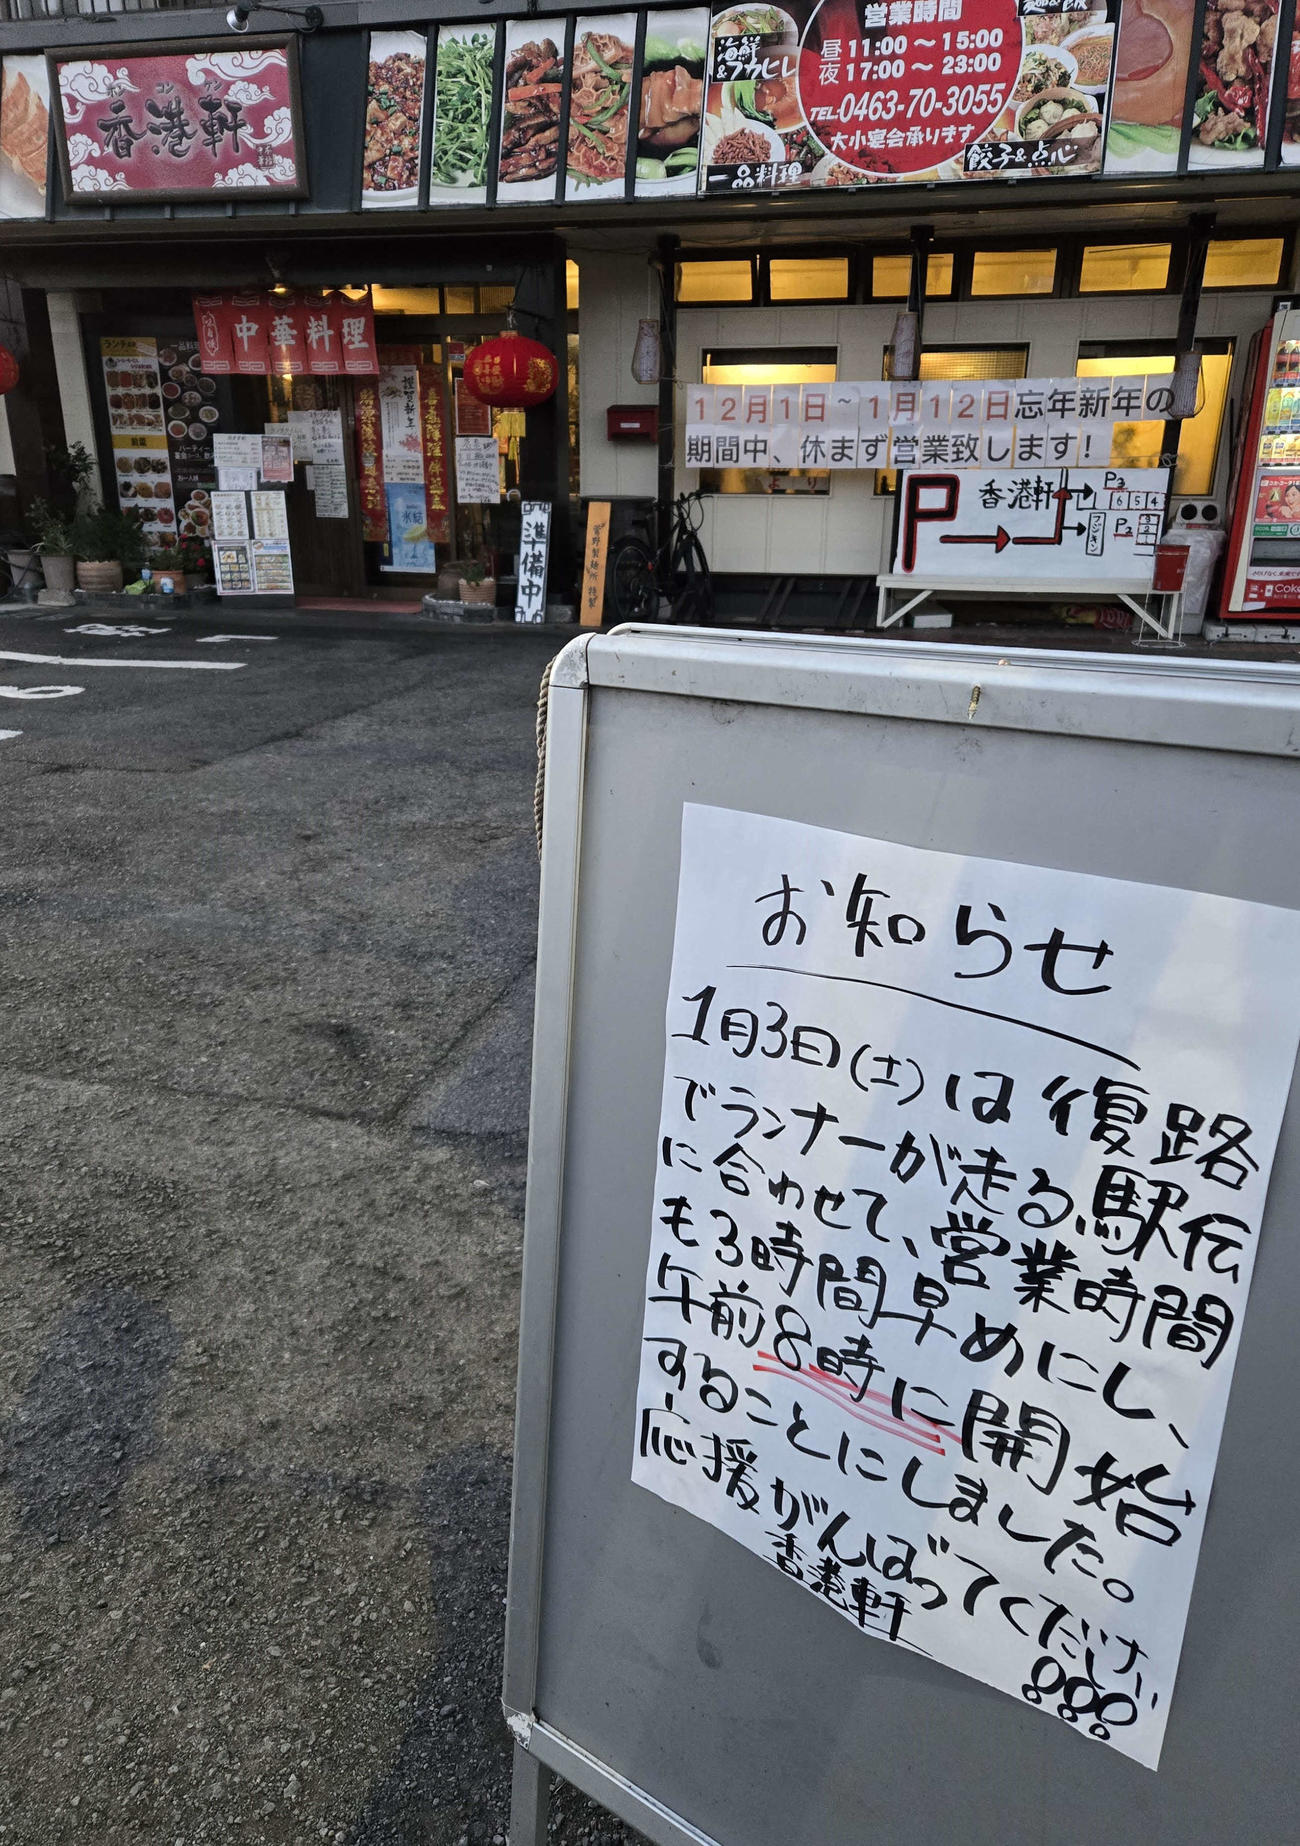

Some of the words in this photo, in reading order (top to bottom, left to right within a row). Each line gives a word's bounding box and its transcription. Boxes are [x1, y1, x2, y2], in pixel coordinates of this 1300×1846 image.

[864, 2, 962, 29] 営業時間
[717, 35, 761, 62] 海鮮
[818, 63, 839, 86] 夜
[846, 59, 905, 82] 17:00
[942, 52, 1001, 74] 23:00
[821, 39, 842, 61] 昼
[848, 36, 908, 58] 11:00
[943, 28, 1003, 51] 15:00
[155, 82, 174, 94] コン
[96, 95, 247, 159] 香港軒
[830, 124, 975, 152] 大小宴会承ります
[708, 160, 803, 188] 一品料理
[234, 314, 369, 352] 中華料理
[687, 432, 1092, 466] 期間中、休まず営業致します!
[979, 475, 1053, 511] 香港軒
[902, 474, 960, 573] P
[1115, 517, 1133, 534] P2
[521, 521, 547, 609] 準備中
[754, 873, 1114, 995] お知らせ
[671, 985, 1260, 1191] 1月3日(土)は復路
[673, 1074, 1252, 1284] でランナーが走る駅伝
[662, 1135, 1235, 1369] に合わせて、営業時間
[659, 1196, 1190, 1448] も3時間早めにし、
[648, 1252, 1197, 1548] 午前8時に開始
[643, 1337, 1135, 1603] することにしました。
[751, 1530, 913, 1642] 香港軒
